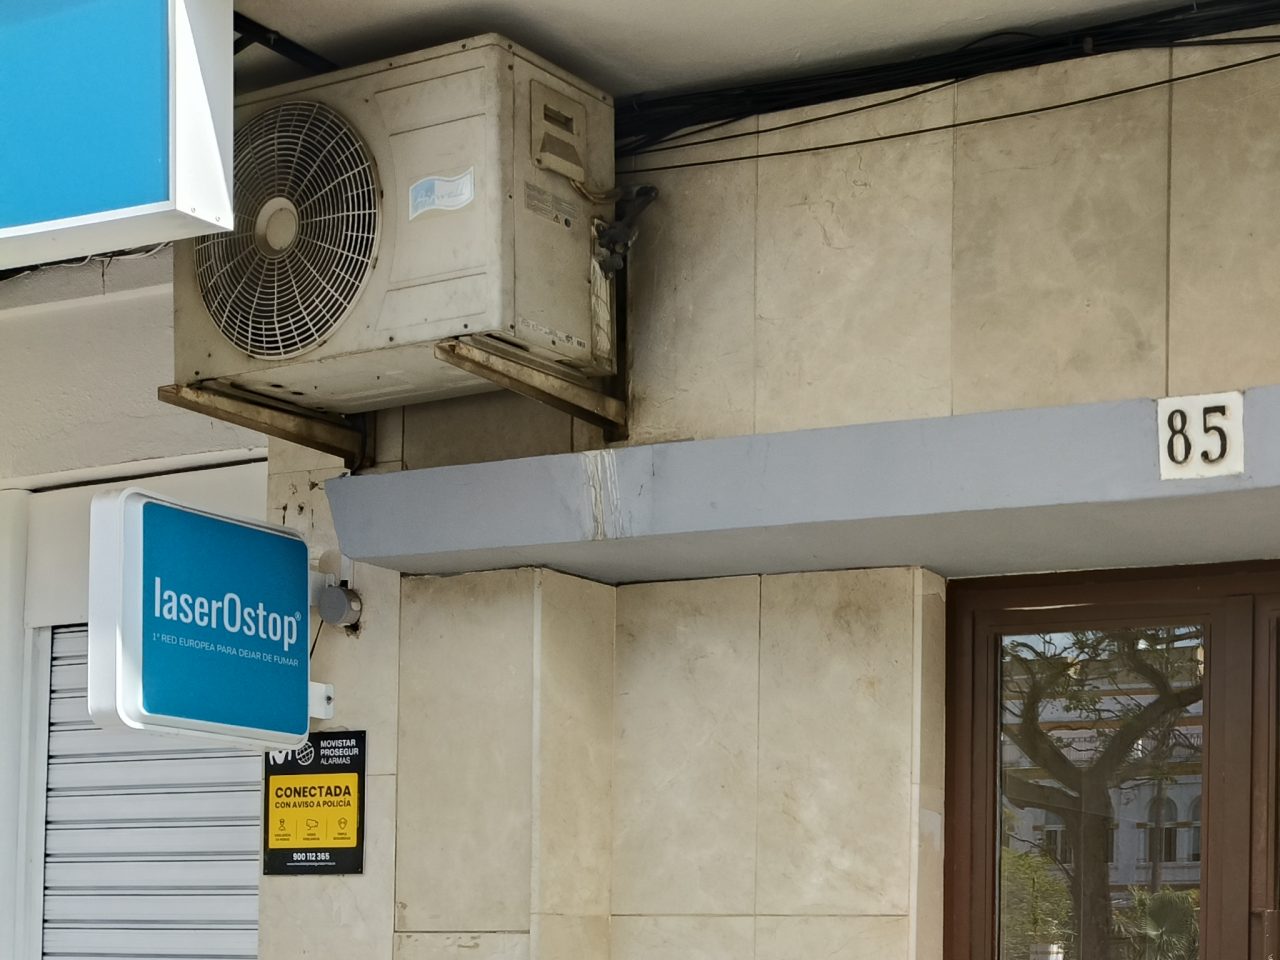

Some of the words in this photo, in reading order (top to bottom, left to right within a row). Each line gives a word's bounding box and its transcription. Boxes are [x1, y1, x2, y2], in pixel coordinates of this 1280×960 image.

[1167, 405, 1227, 464] 85
[161, 634, 177, 645] RED
[179, 637, 215, 652] EUROPEA
[217, 644, 238, 656] PARA
[262, 652, 273, 663] DE
[274, 655, 299, 667] FUMAR
[320, 739, 356, 748] MOVISTAR
[320, 748, 359, 756] PROSEGUR
[320, 756, 351, 765] ALARMAS
[275, 785, 352, 798] CONECTADA
[275, 801, 291, 809] CON
[292, 800, 315, 809] AVISO
[322, 798, 352, 808] POLICÍA
[292, 852, 306, 861] 900
[307, 852, 316, 861] 112
[317, 852, 330, 861] 365
